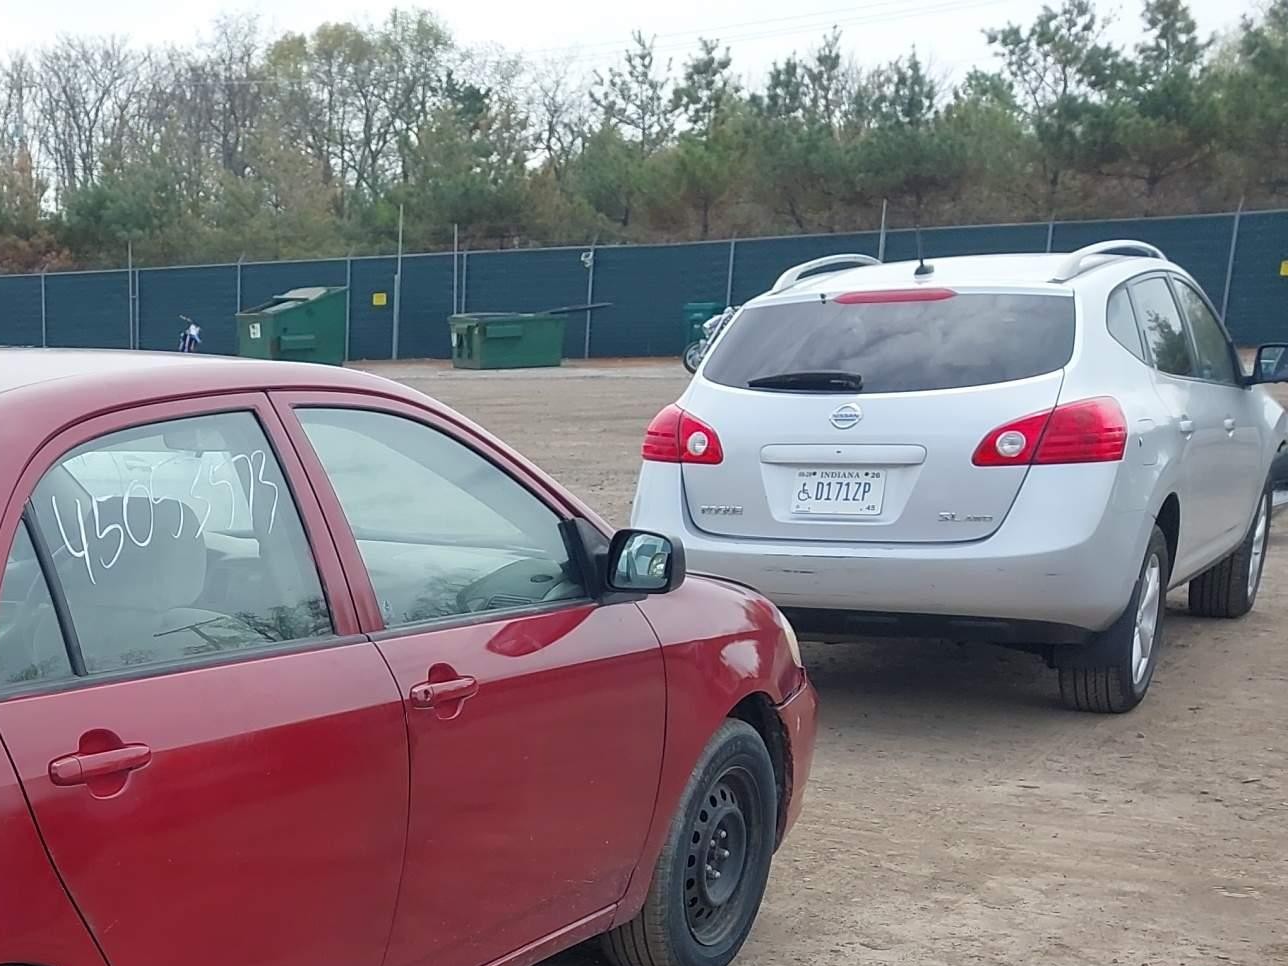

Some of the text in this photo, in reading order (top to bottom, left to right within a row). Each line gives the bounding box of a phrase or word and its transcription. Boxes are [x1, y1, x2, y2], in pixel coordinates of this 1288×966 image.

[820, 471, 860, 479] INDIANA
[815, 481, 871, 501] D171ZP
[51, 449, 280, 585] 45053573
